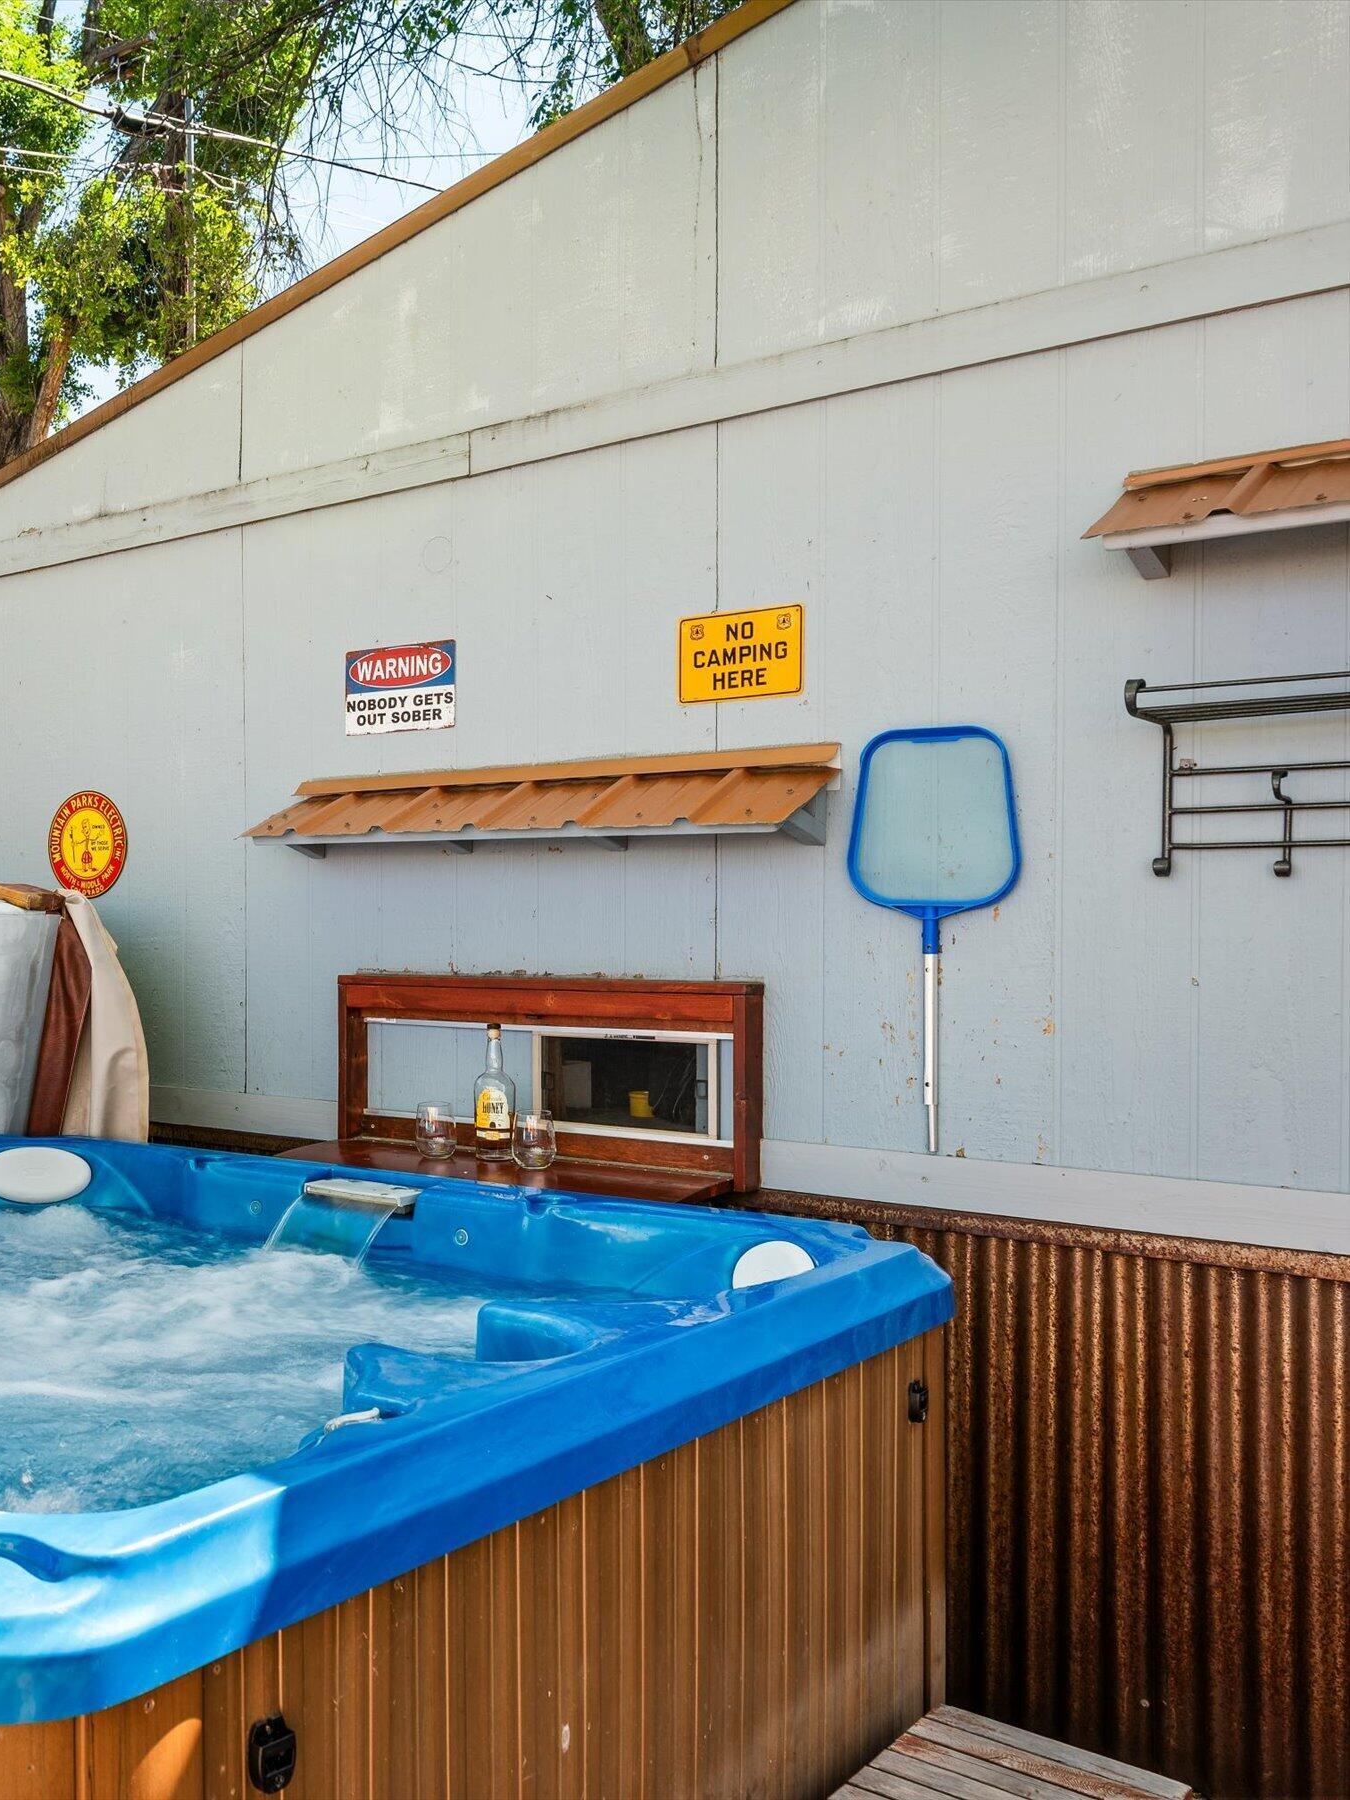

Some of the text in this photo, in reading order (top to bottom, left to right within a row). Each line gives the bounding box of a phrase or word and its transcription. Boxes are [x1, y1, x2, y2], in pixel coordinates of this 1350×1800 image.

[726, 621, 754, 642] NO
[357, 653, 442, 682] WARNING
[693, 641, 788, 669] CAMPING
[713, 667, 767, 691] HERE
[346, 691, 454, 713] NOBODY GETS
[356, 708, 442, 726] OUT SOBER
[51, 806, 72, 864] MOUNTAIN
[71, 795, 100, 811] PARKS
[99, 800, 124, 848] ELECTRIC
[60, 865, 77, 886] NORTH
[80, 877, 101, 890] MIDDLE
[101, 864, 115, 882] PARK
